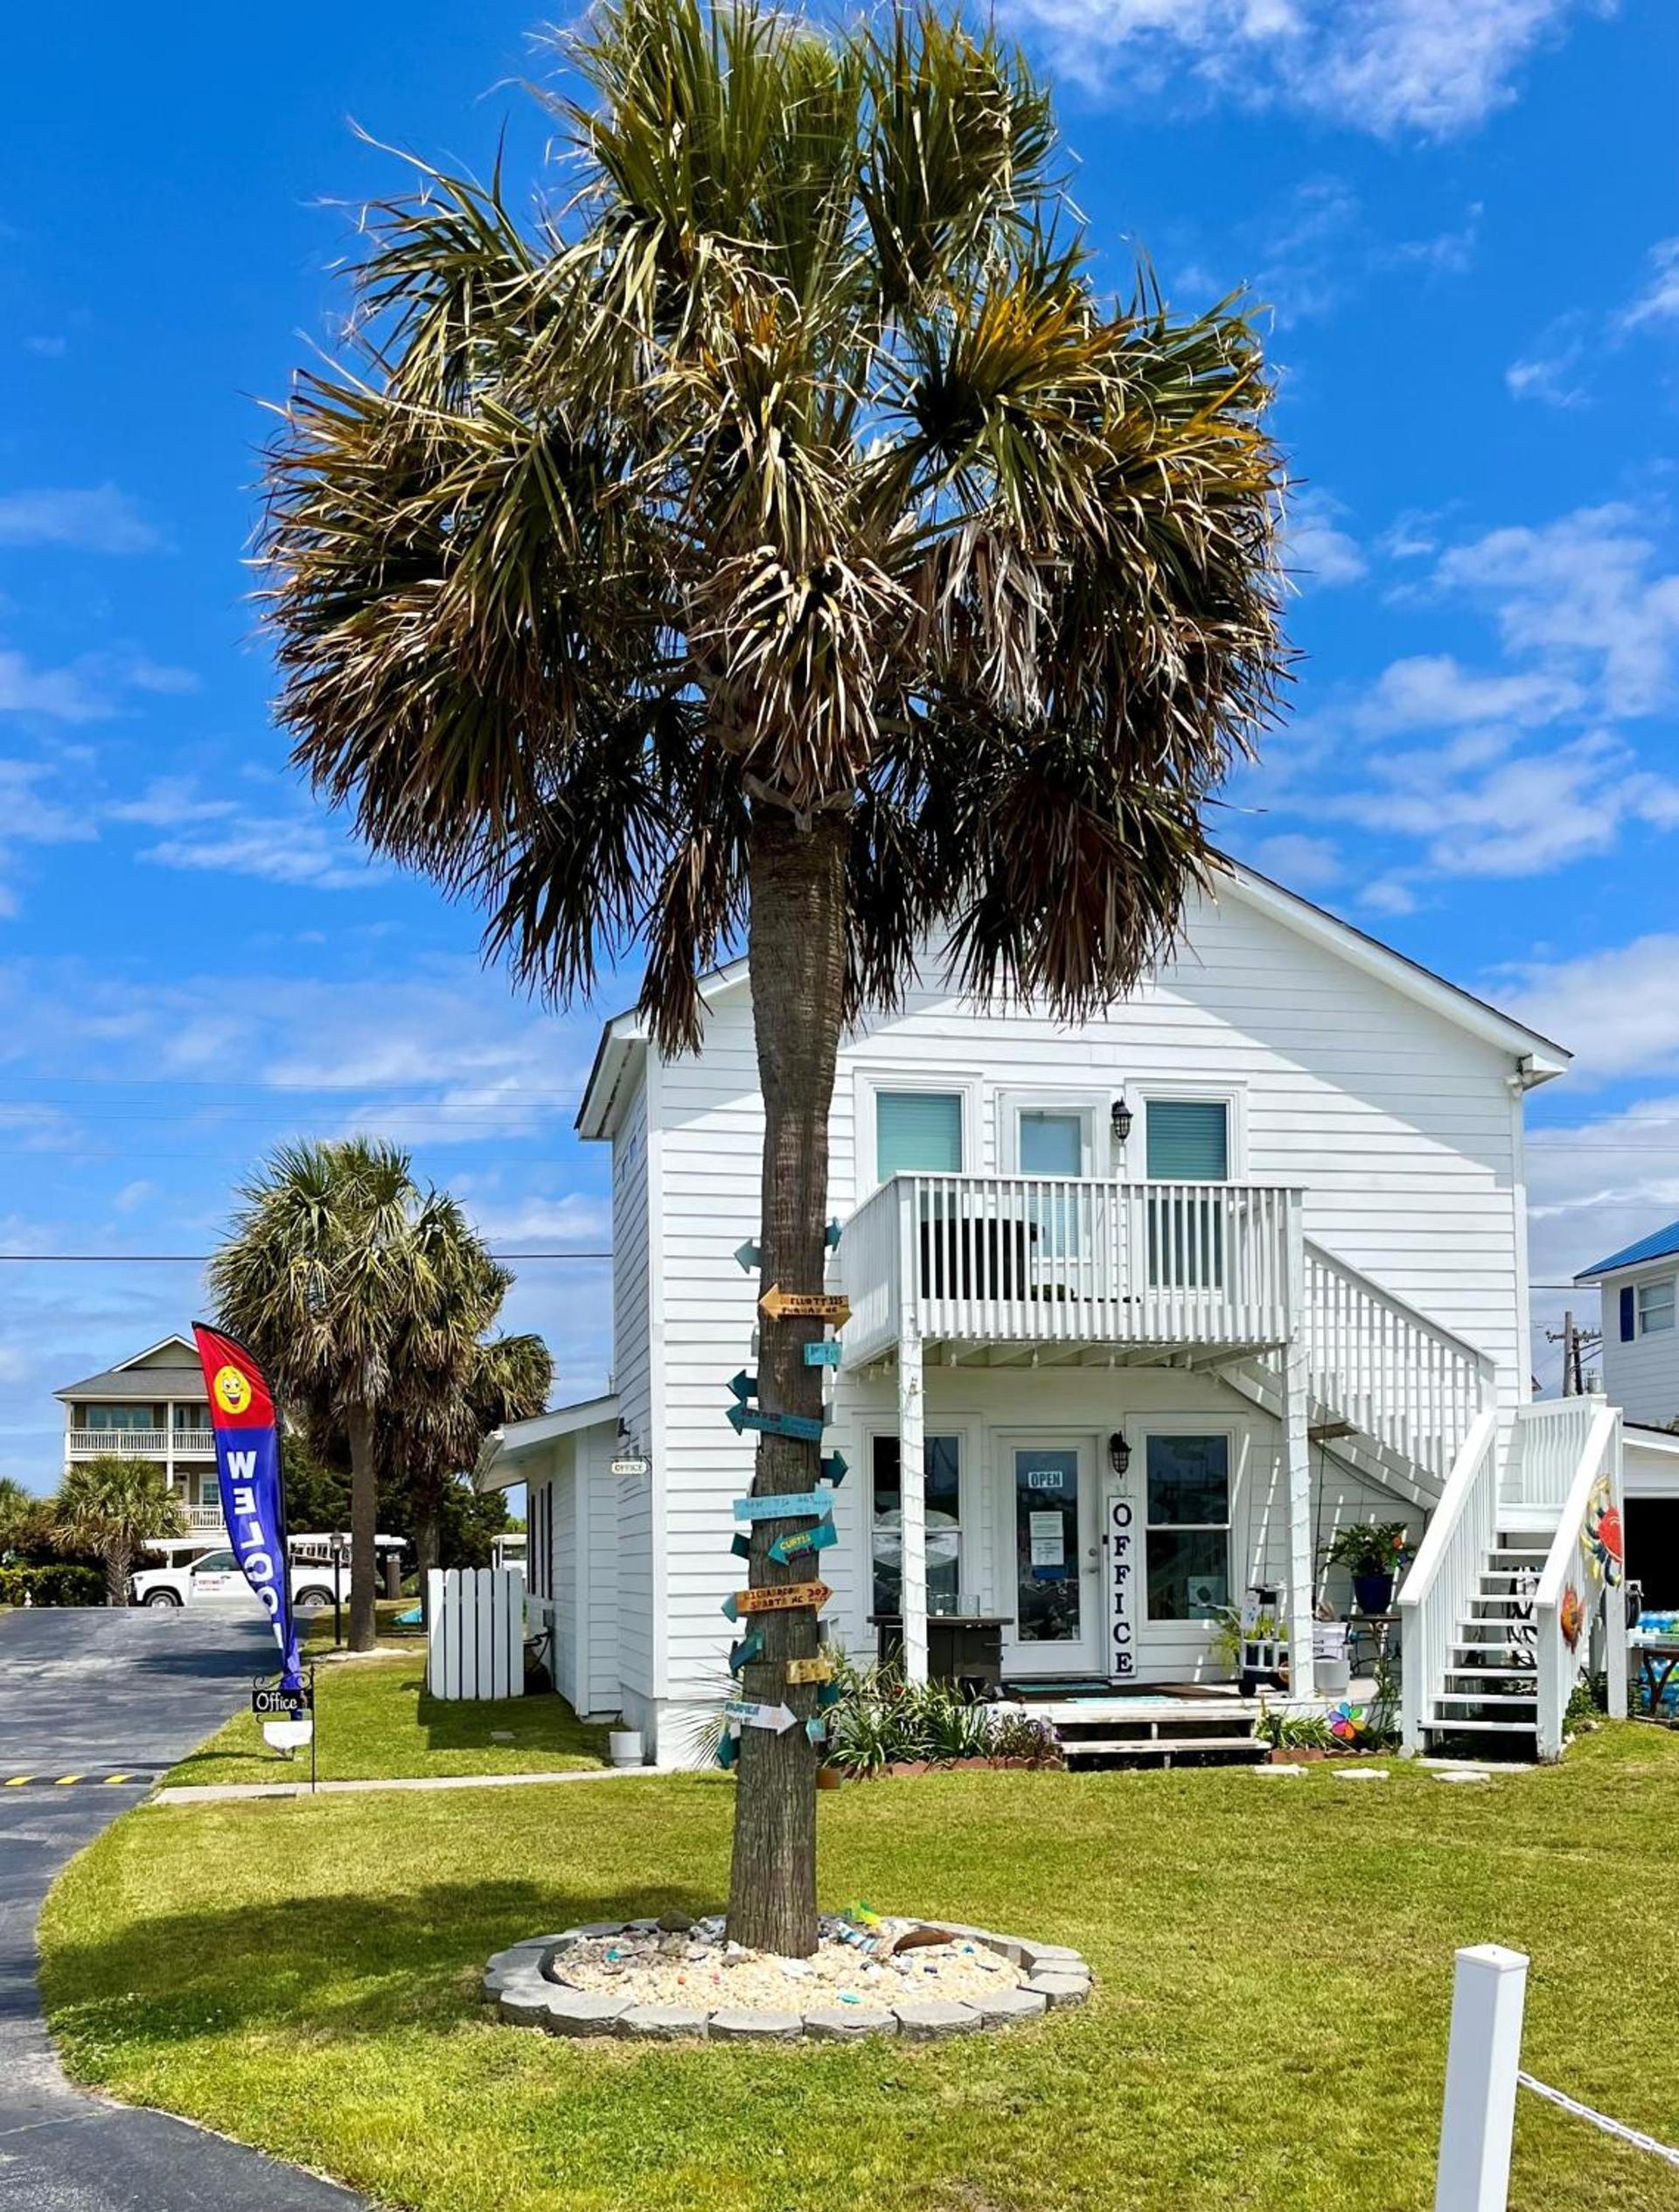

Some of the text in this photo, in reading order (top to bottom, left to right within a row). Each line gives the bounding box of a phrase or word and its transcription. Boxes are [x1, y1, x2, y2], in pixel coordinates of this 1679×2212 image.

[1030, 1472, 1062, 1487] OPEN
[1112, 1503, 1133, 1673] OFFICE
[256, 1692, 298, 1712] Office
